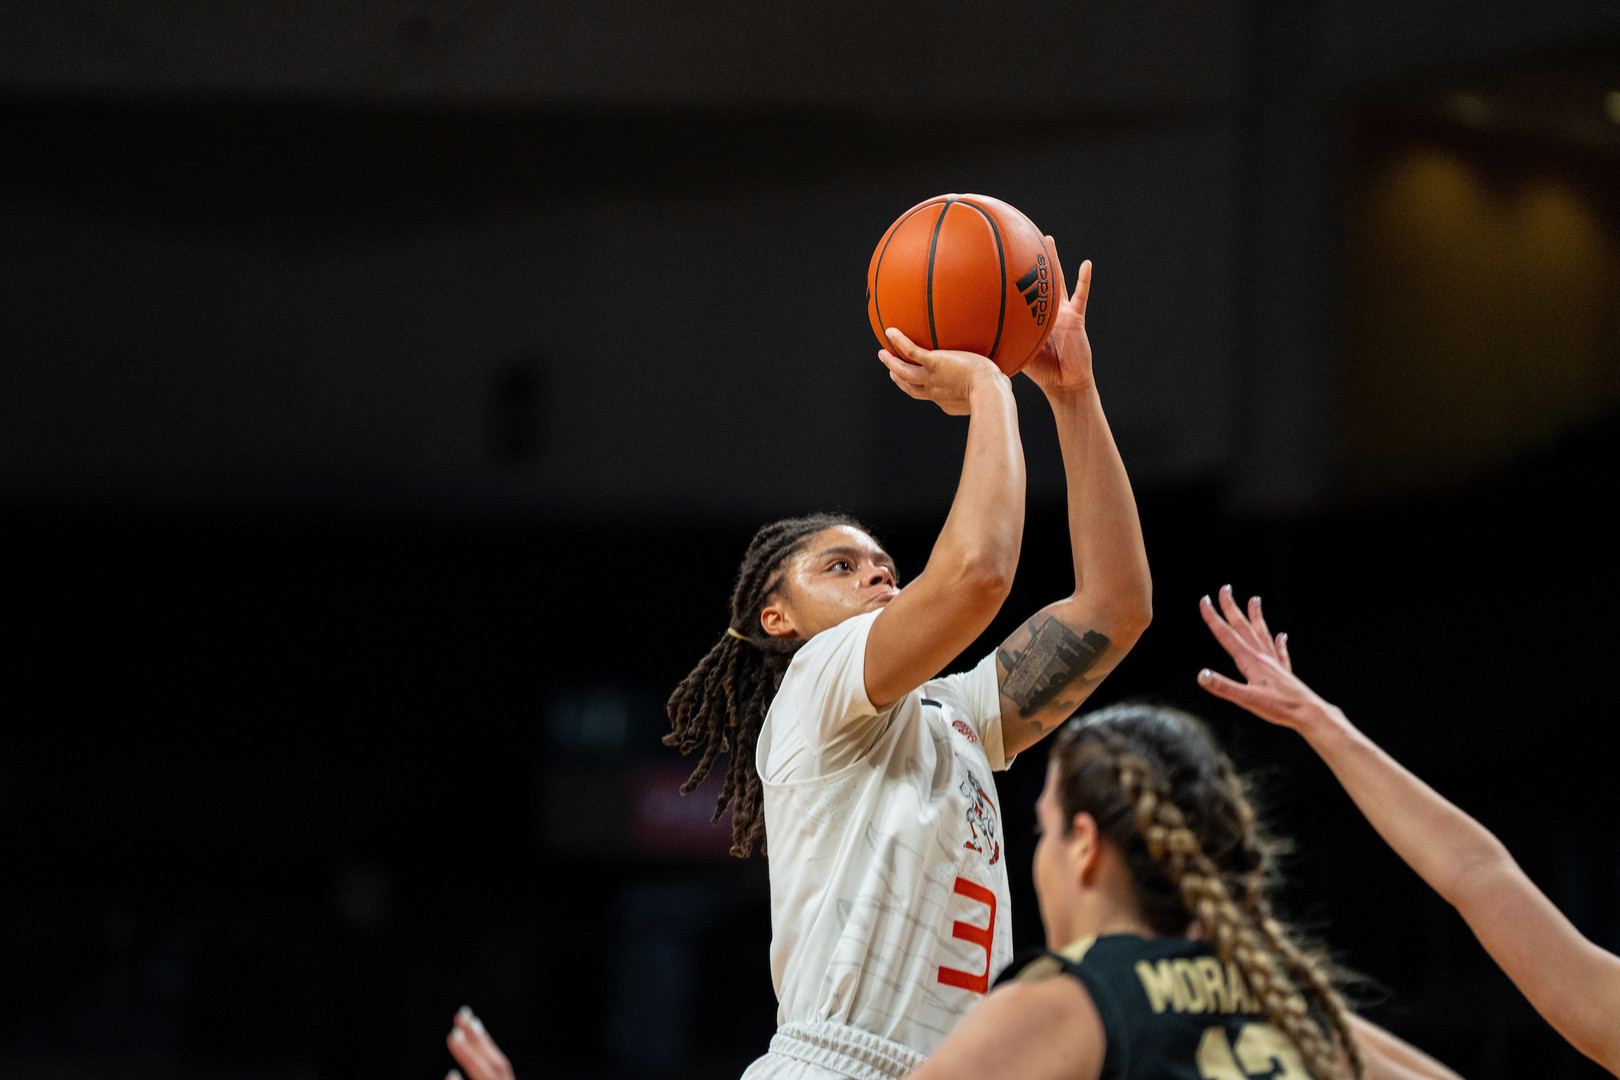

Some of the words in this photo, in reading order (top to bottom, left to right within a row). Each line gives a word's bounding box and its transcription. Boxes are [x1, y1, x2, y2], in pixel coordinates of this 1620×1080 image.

[1036, 254, 1049, 326] adidas
[937, 876, 997, 996] 3
[1133, 955, 1261, 1015] MORA
